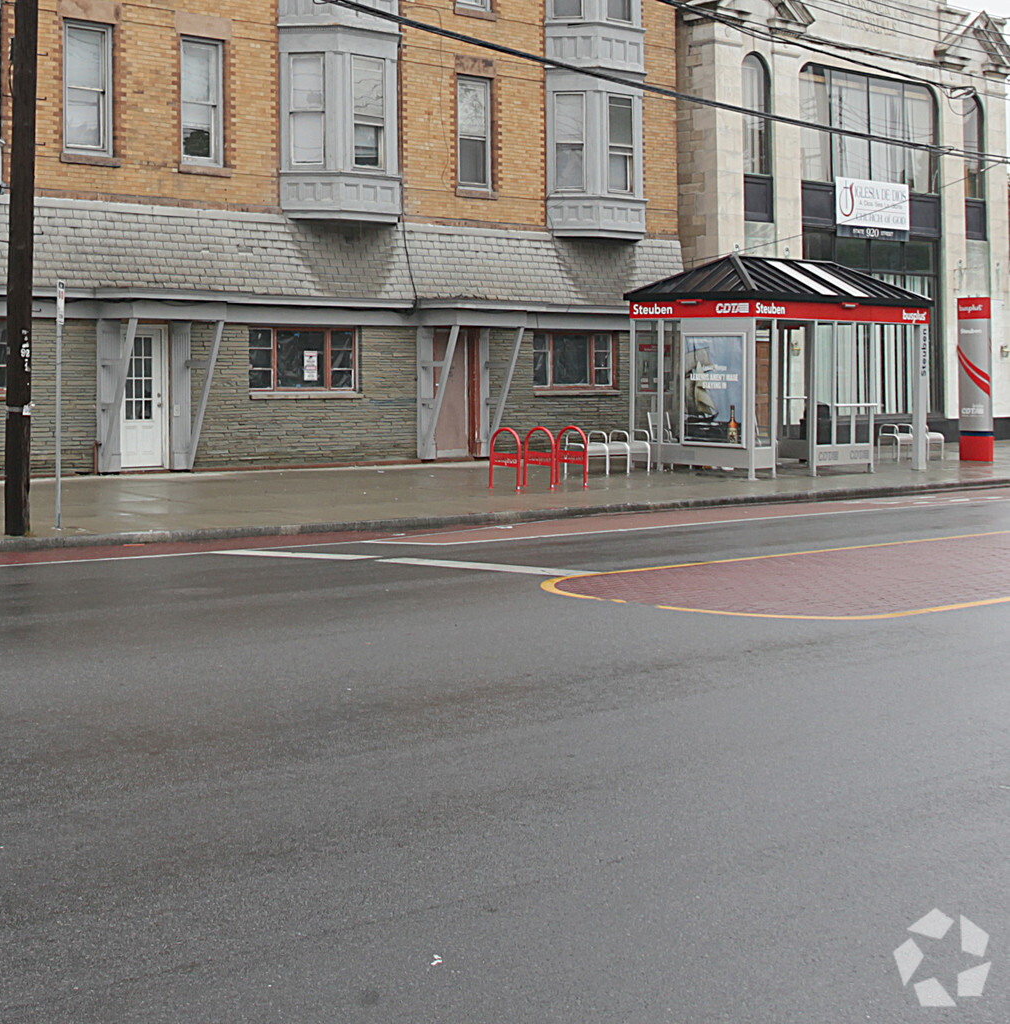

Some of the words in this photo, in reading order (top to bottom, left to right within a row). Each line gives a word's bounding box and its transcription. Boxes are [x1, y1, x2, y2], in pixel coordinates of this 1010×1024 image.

[855, 185, 880, 201] IGLESIA
[882, 188, 891, 201] DE
[892, 189, 907, 202] DIOS
[855, 213, 883, 224] CHURCH
[892, 216, 907, 225] GOD
[866, 227, 880, 238] 920
[632, 302, 673, 315] Steuben
[755, 301, 786, 315] Steuben
[902, 309, 927, 324] busplus
